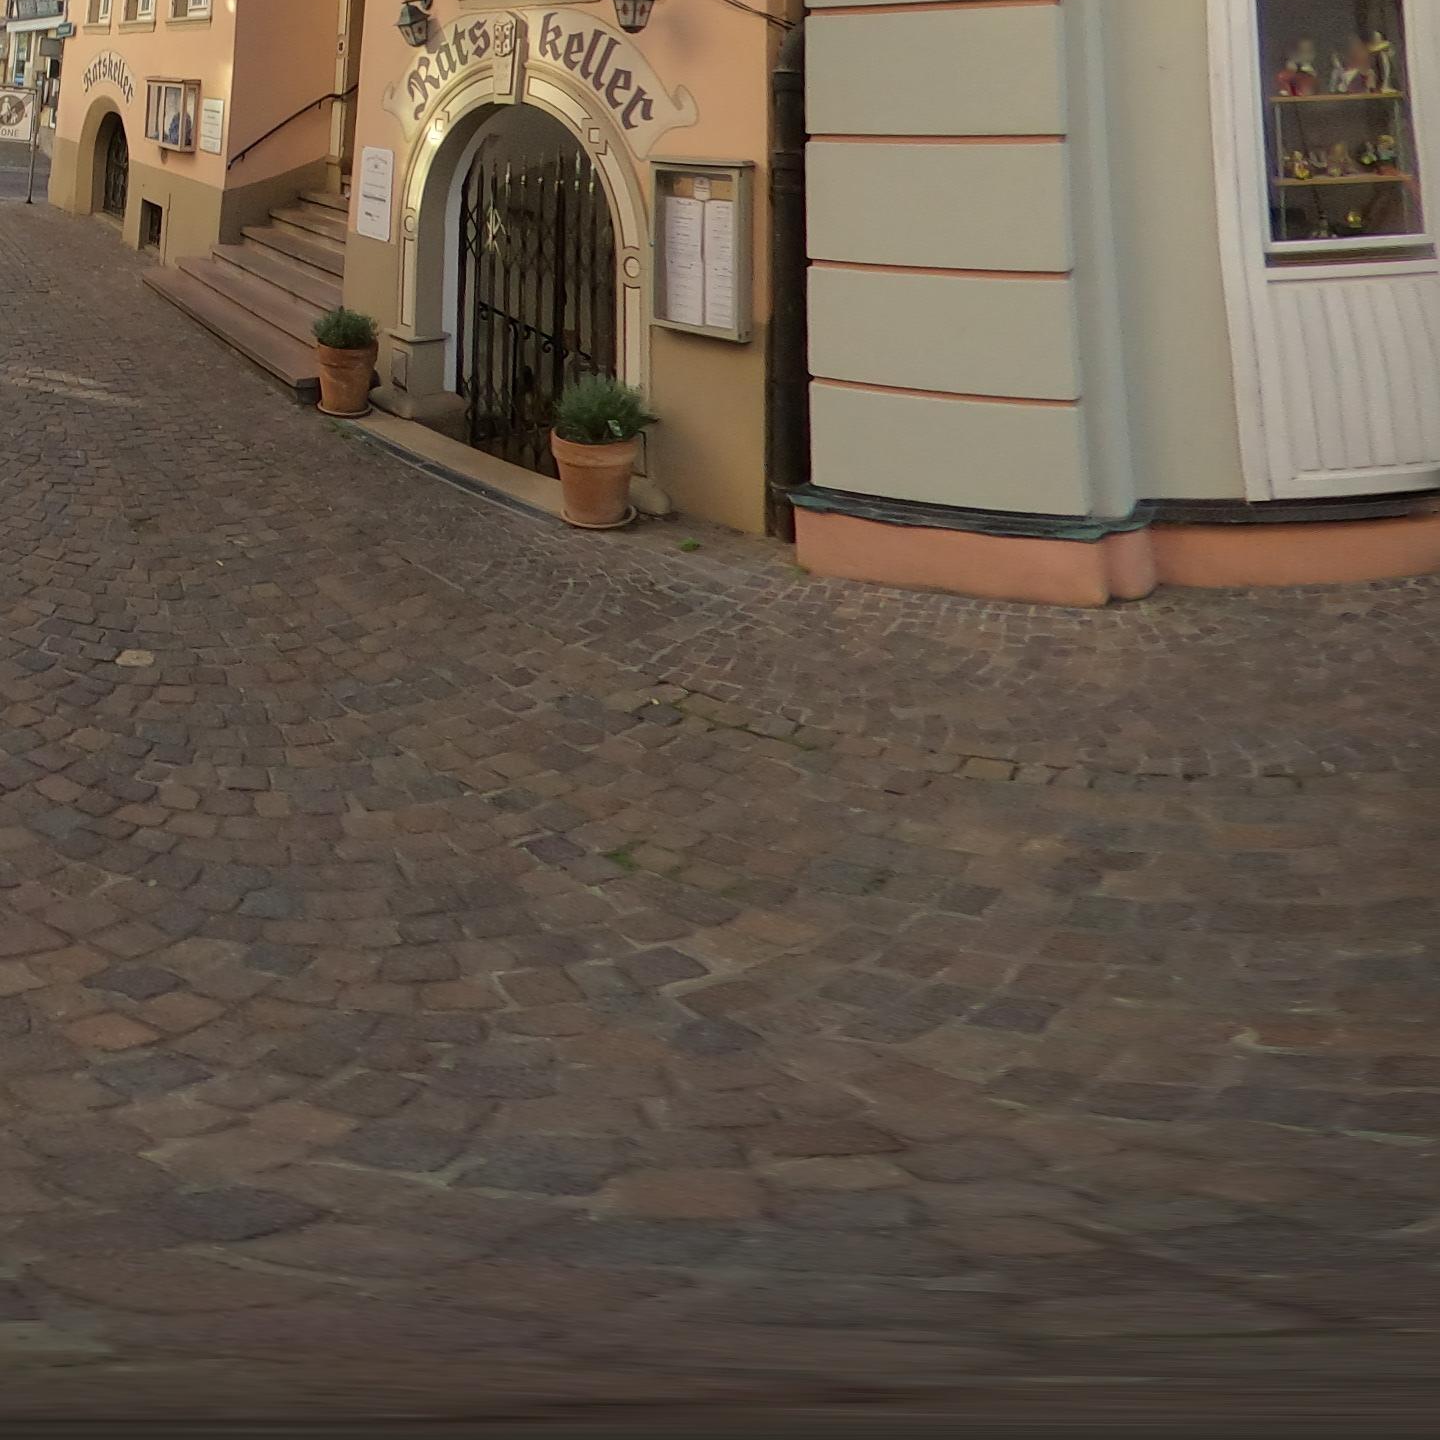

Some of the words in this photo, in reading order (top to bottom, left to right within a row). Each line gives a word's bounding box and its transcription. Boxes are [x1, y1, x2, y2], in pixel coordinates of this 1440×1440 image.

[83, 51, 134, 105] Ratskeller
[407, 18, 491, 121] Rats
[538, 11, 655, 131] keller
